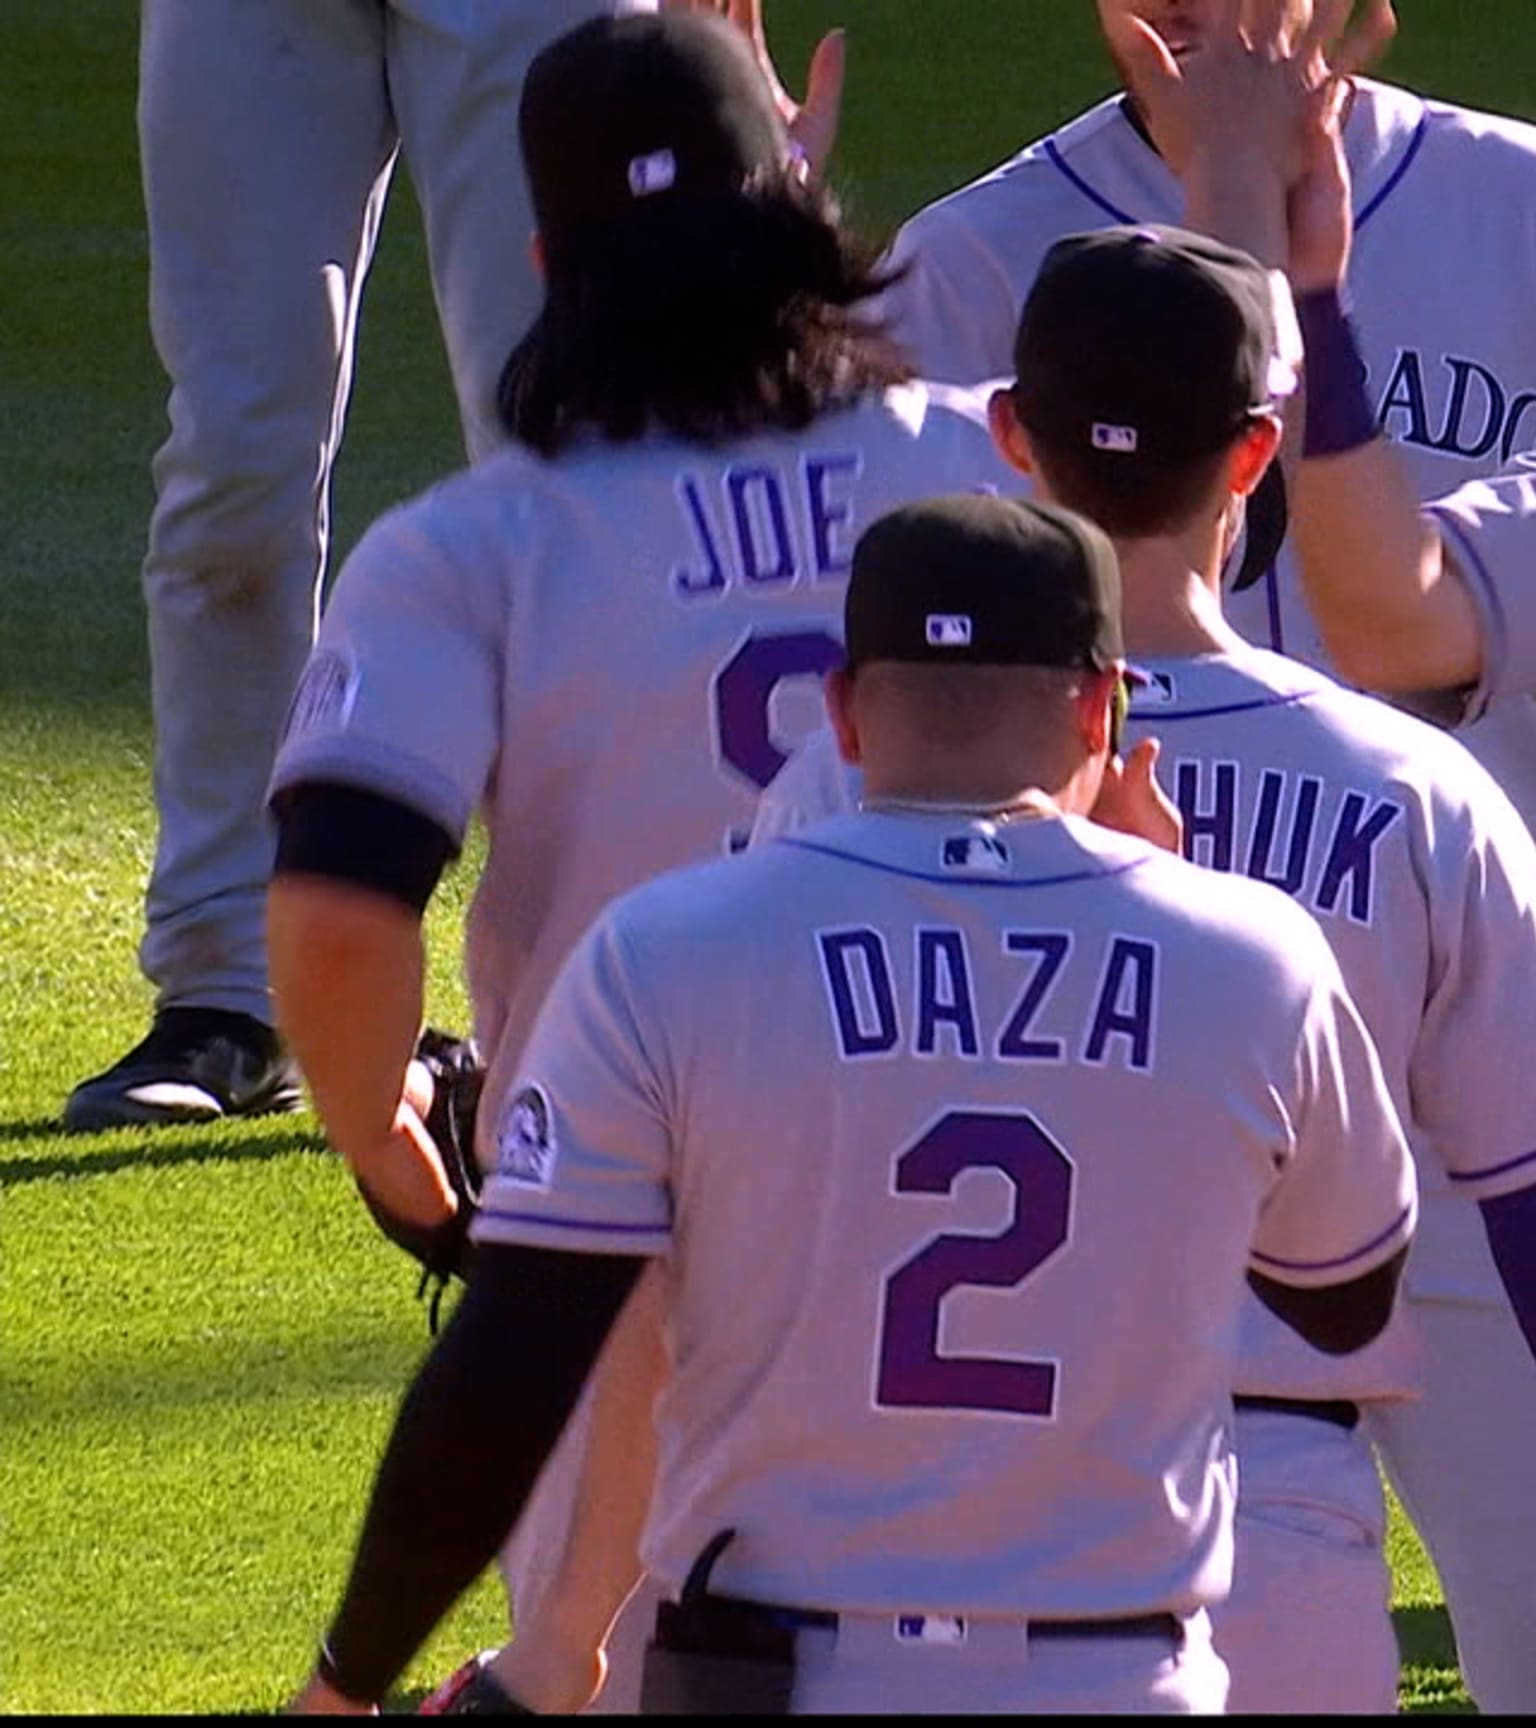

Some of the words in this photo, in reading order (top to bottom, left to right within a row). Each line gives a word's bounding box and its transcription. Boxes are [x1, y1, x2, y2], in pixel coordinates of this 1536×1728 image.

[671, 451, 863, 595] JOE
[816, 924, 1159, 1073] DAZA
[871, 1105, 1077, 1422] 2
